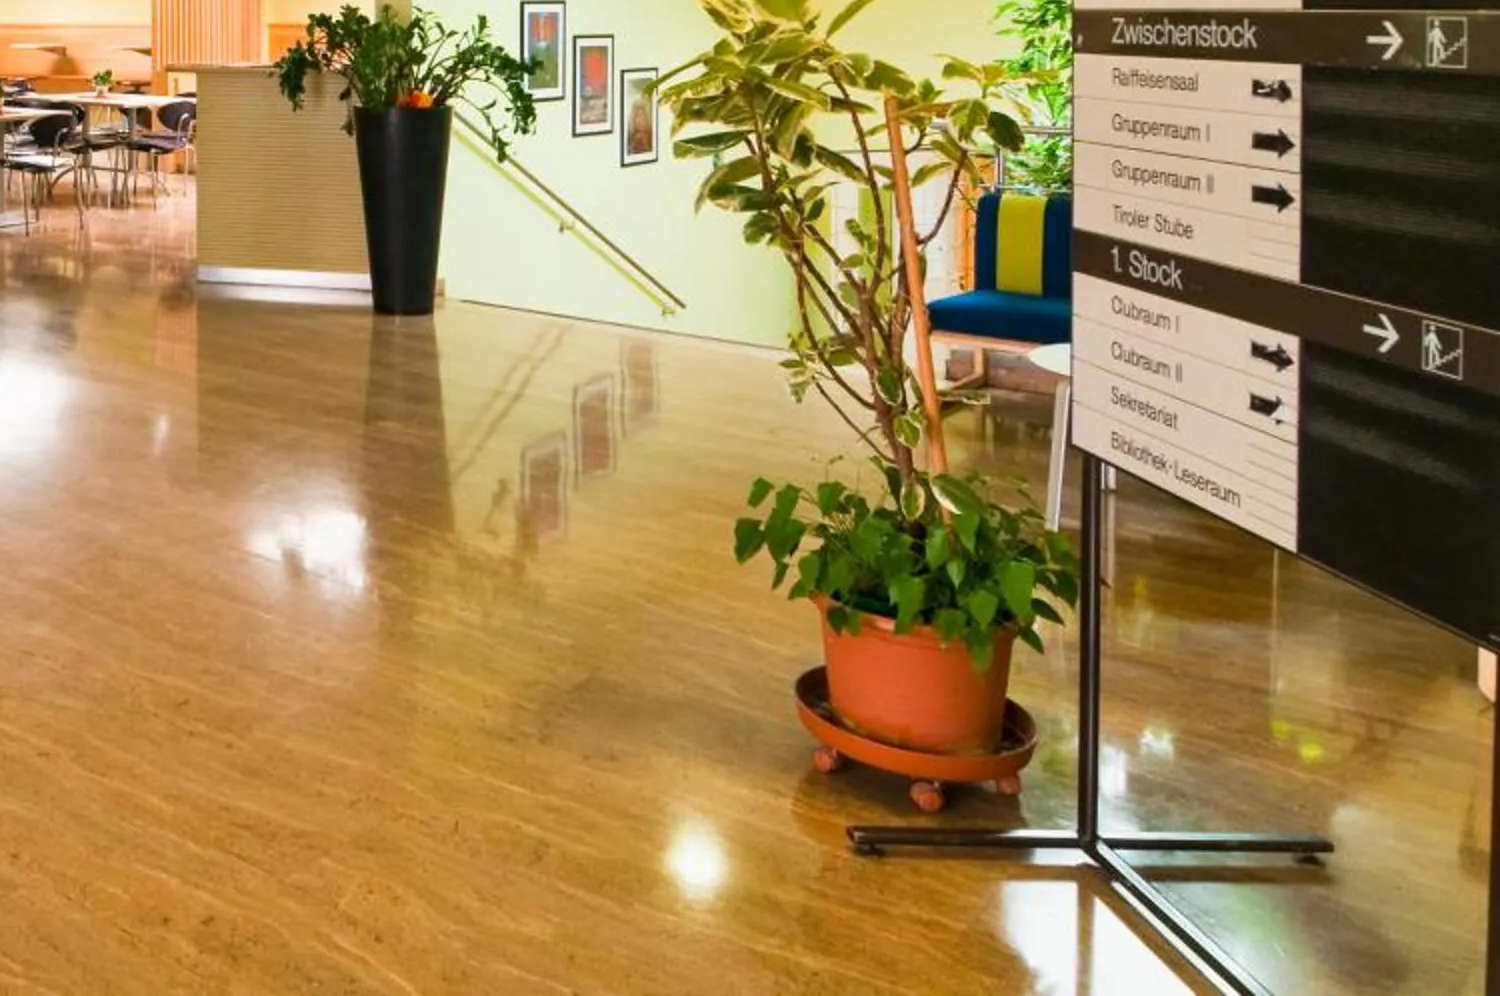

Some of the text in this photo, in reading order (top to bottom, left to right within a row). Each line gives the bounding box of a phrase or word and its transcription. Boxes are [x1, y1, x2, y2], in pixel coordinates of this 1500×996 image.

[1111, 17, 1258, 49] Zwischenstock
[1111, 67, 1199, 93] Raiffeisensaal
[1111, 112, 1211, 143] Gruppenraum I
[1111, 158, 1201, 192] Gruppenraum
[1111, 204, 1194, 239] Tiroler Stube
[1110, 244, 1184, 291] 1. Stock
[1110, 295, 1172, 331] Clubraum
[1110, 339, 1172, 377] Clubraum
[1110, 386, 1180, 431] Sekretariat
